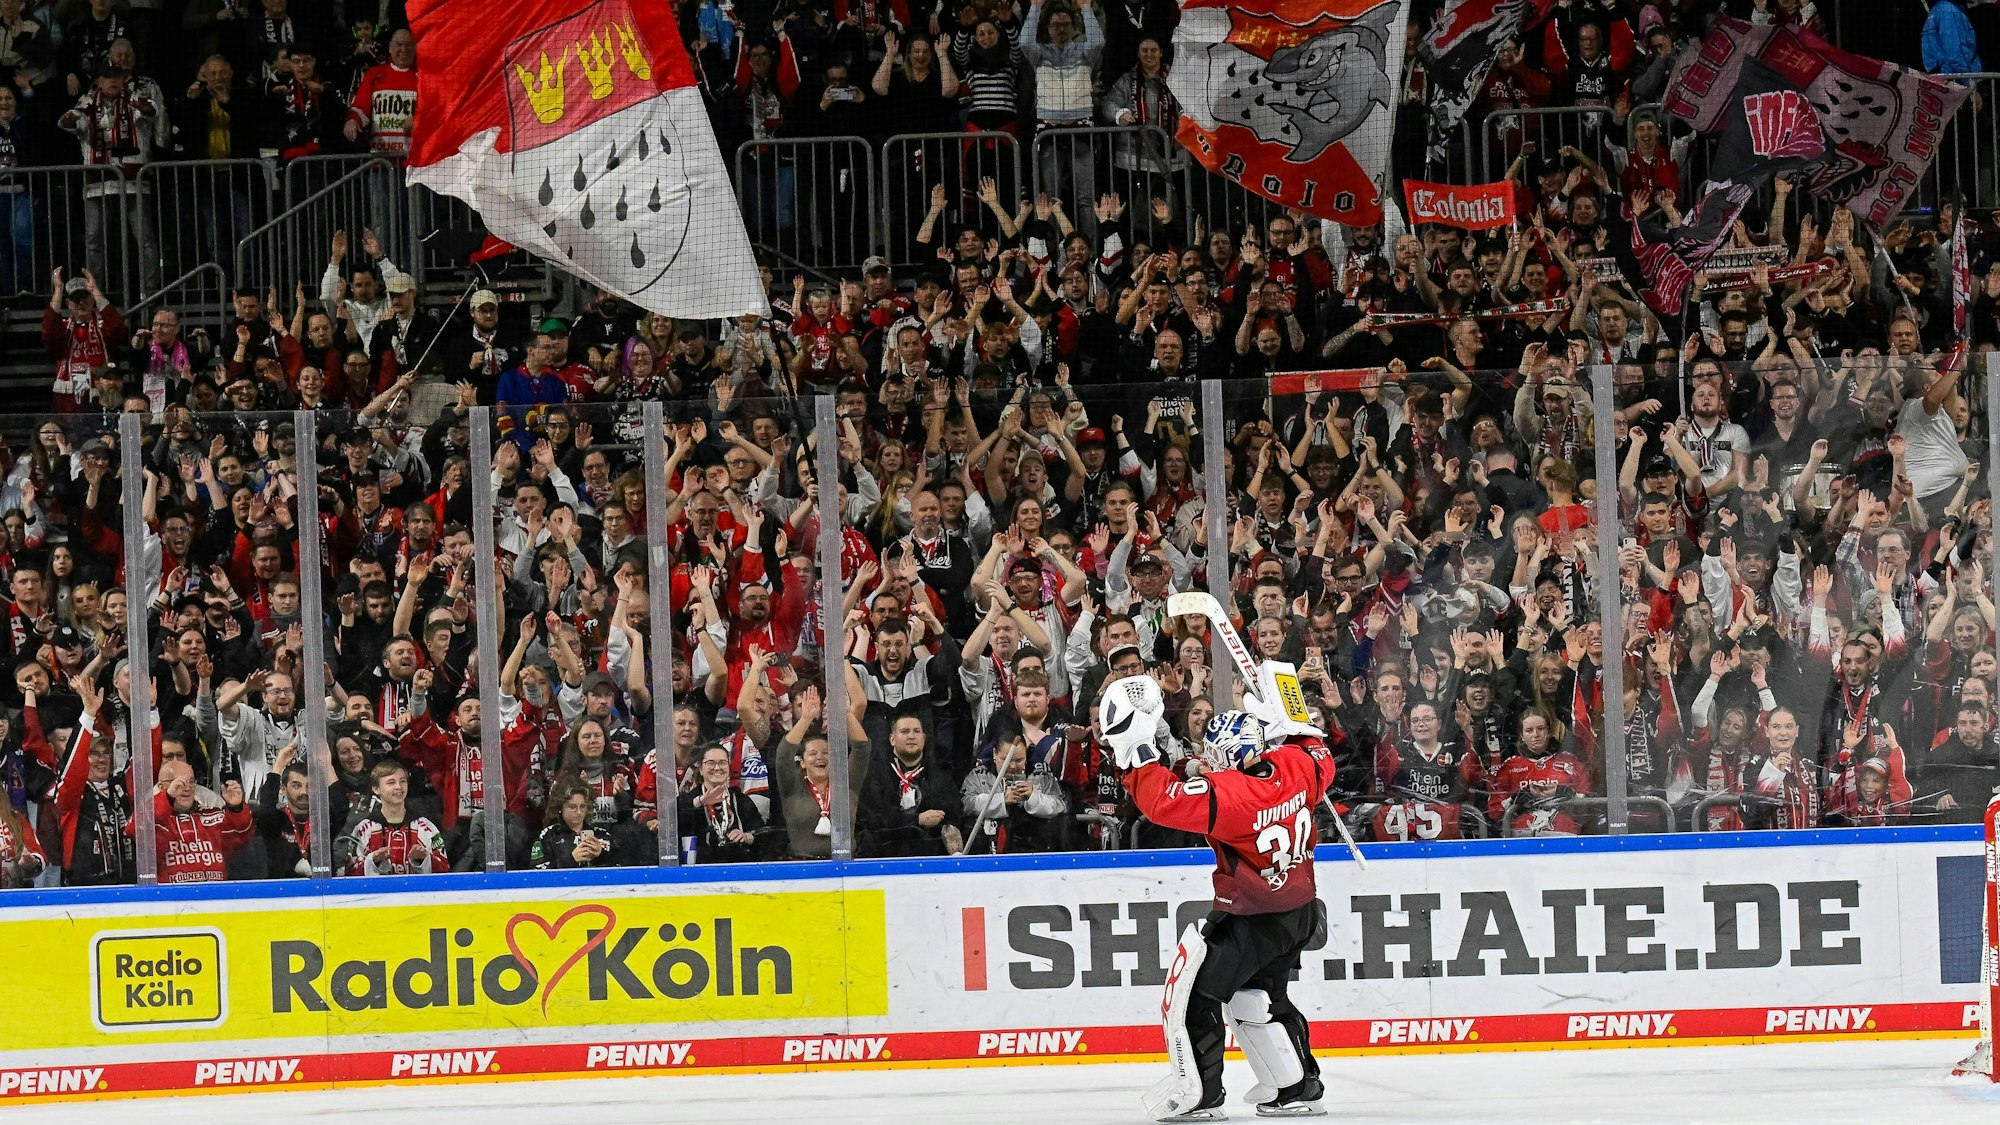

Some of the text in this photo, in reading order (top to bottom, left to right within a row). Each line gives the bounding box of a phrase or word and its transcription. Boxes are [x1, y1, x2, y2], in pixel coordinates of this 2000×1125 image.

[1412, 189, 1505, 223] Colonia
[1282, 681, 1298, 717] Radio
[1290, 686, 1304, 715] Köln
[1409, 781, 1450, 798] nergie
[1384, 803, 1443, 842] 45
[168, 839, 213, 853] Rhein
[1255, 806, 1313, 878] 30
[164, 851, 224, 867] Energie
[1007, 879, 1862, 990] SH.HAIE.DE
[116, 949, 202, 979] Radio
[271, 917, 793, 1013] Radio Köln
[126, 980, 194, 1010] Köln
